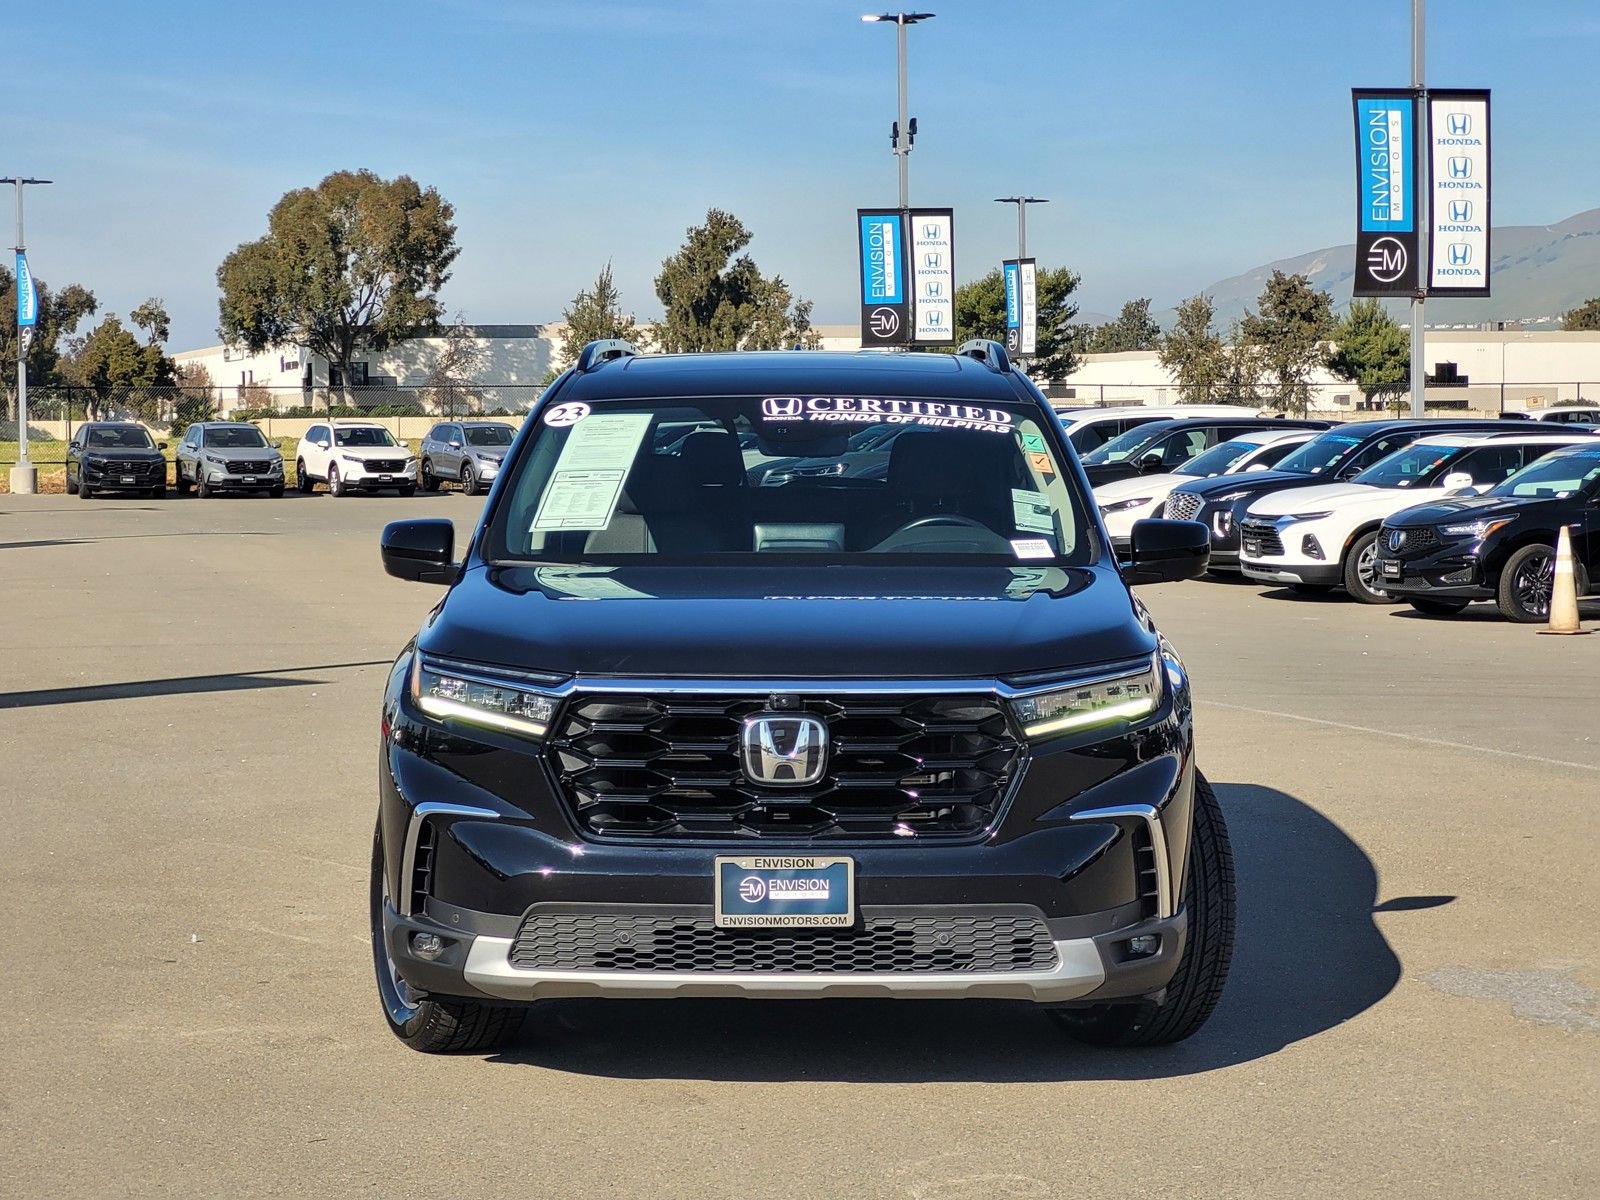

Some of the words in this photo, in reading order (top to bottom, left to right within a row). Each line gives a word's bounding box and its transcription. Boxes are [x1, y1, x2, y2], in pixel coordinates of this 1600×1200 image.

[1437, 138, 1482, 146] HONDA
[1369, 110, 1389, 221] ENVISION
[1392, 120, 1400, 211] MOTORS
[869, 223, 885, 297] ENVISION
[1437, 268, 1481, 276] HONDA
[549, 407, 584, 422] 23
[806, 397, 1012, 425] CERTIFIED
[809, 412, 876, 424] HONDA
[890, 415, 915, 424] OF
[917, 417, 1011, 434] MILPITAS
[754, 858, 815, 868] ENVISION
[769, 879, 830, 891] ENVISION
[722, 916, 848, 926] ENVISIONMOTORS.COM
